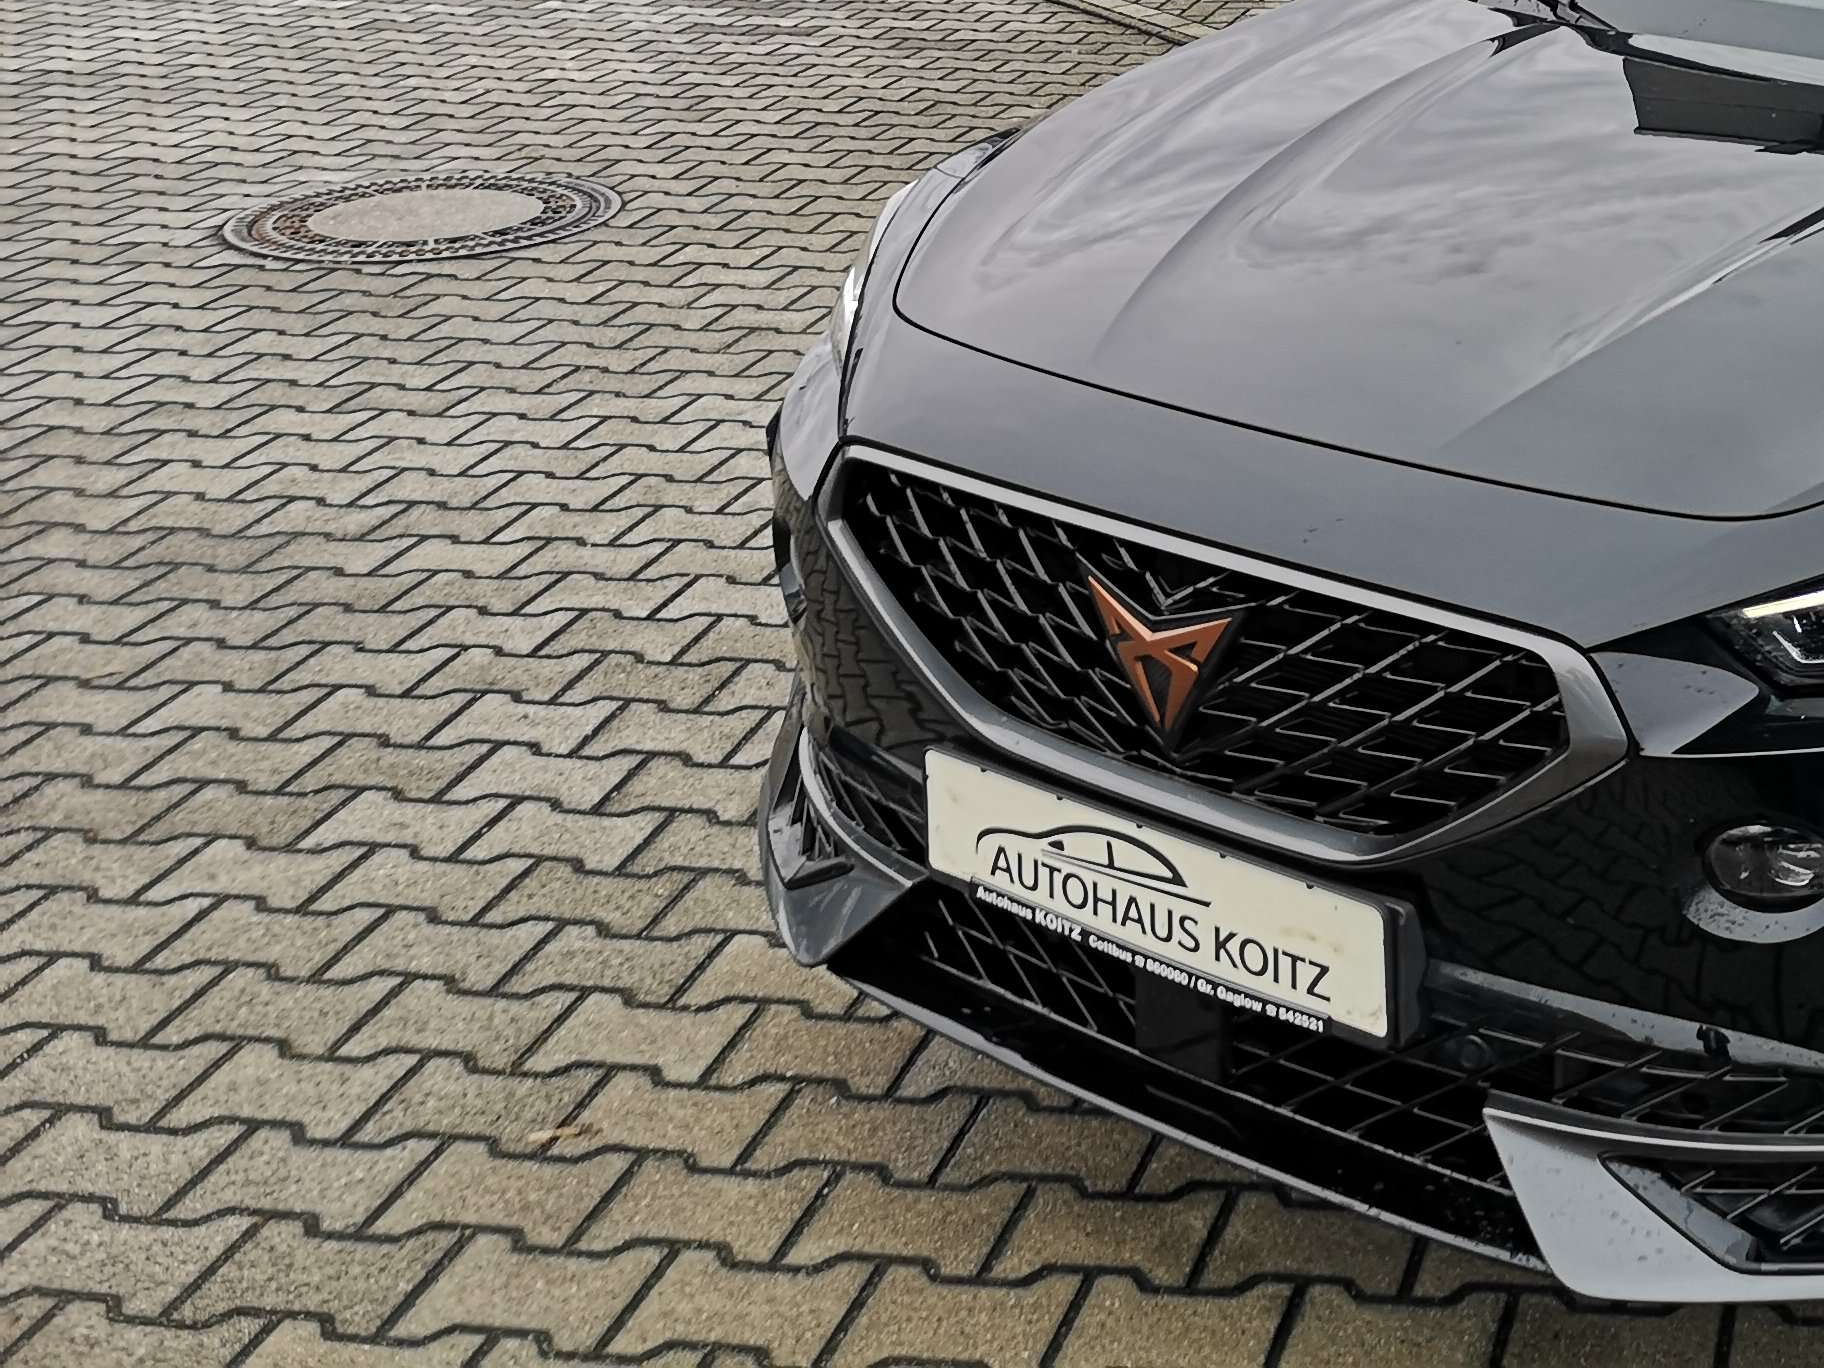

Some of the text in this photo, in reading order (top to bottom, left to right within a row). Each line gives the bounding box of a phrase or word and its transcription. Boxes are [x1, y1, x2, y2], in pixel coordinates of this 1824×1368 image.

[976, 885, 1032, 920] Autohaus
[1035, 907, 1082, 942] KOITZ
[990, 845, 1331, 1002] AUTOHAUS KOITZ
